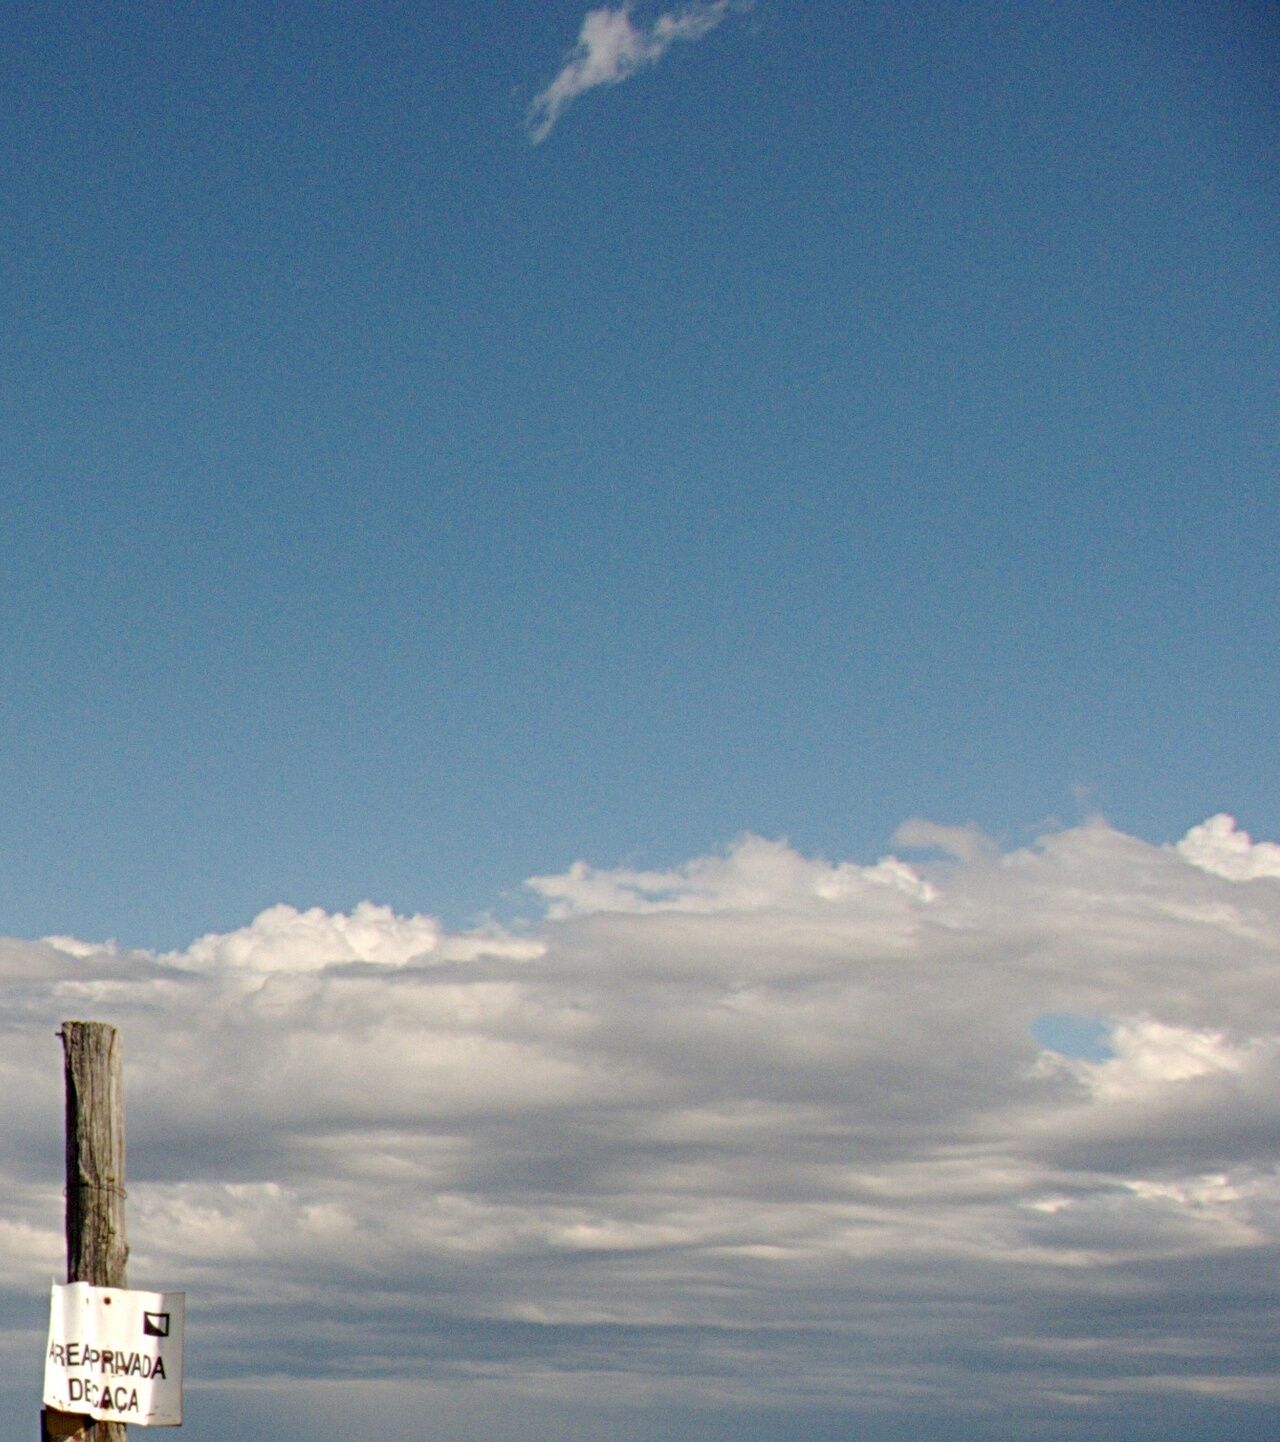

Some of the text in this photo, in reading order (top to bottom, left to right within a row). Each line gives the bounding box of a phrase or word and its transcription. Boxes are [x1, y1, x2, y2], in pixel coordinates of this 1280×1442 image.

[90, 1349, 166, 1380] PRIVADA
[68, 1378, 139, 1414] DE CAÇA
